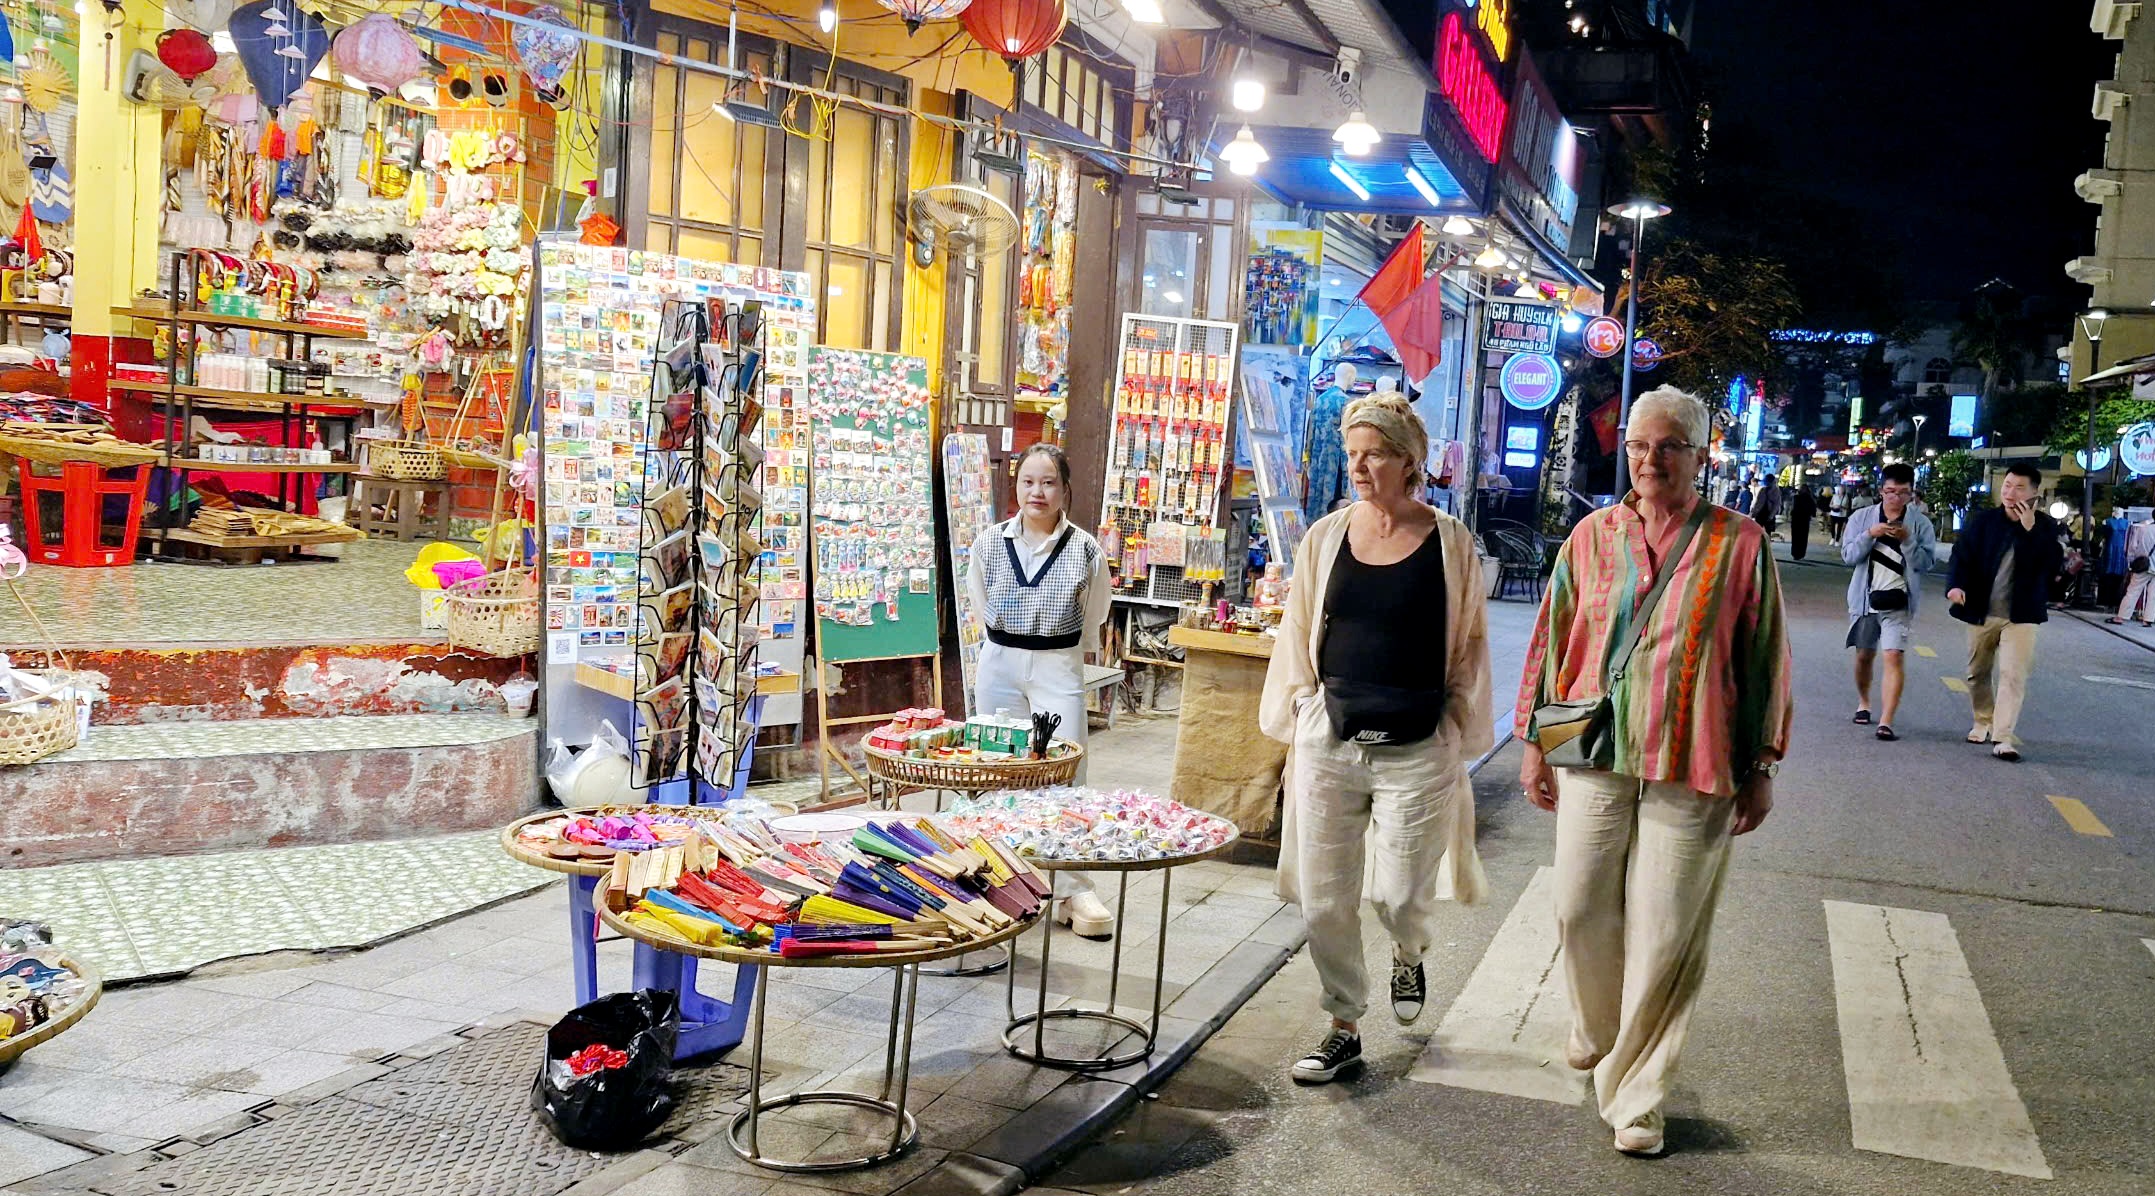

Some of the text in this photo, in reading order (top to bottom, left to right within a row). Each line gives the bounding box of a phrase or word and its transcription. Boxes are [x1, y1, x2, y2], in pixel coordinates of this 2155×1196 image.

[1441, 13, 1508, 163] GALLERY
[1491, 303, 1510, 320] GIA
[1494, 321, 1549, 342] TAILOR
[1514, 372, 1548, 386] ELEGANT
[1357, 730, 1389, 740] NIKE
